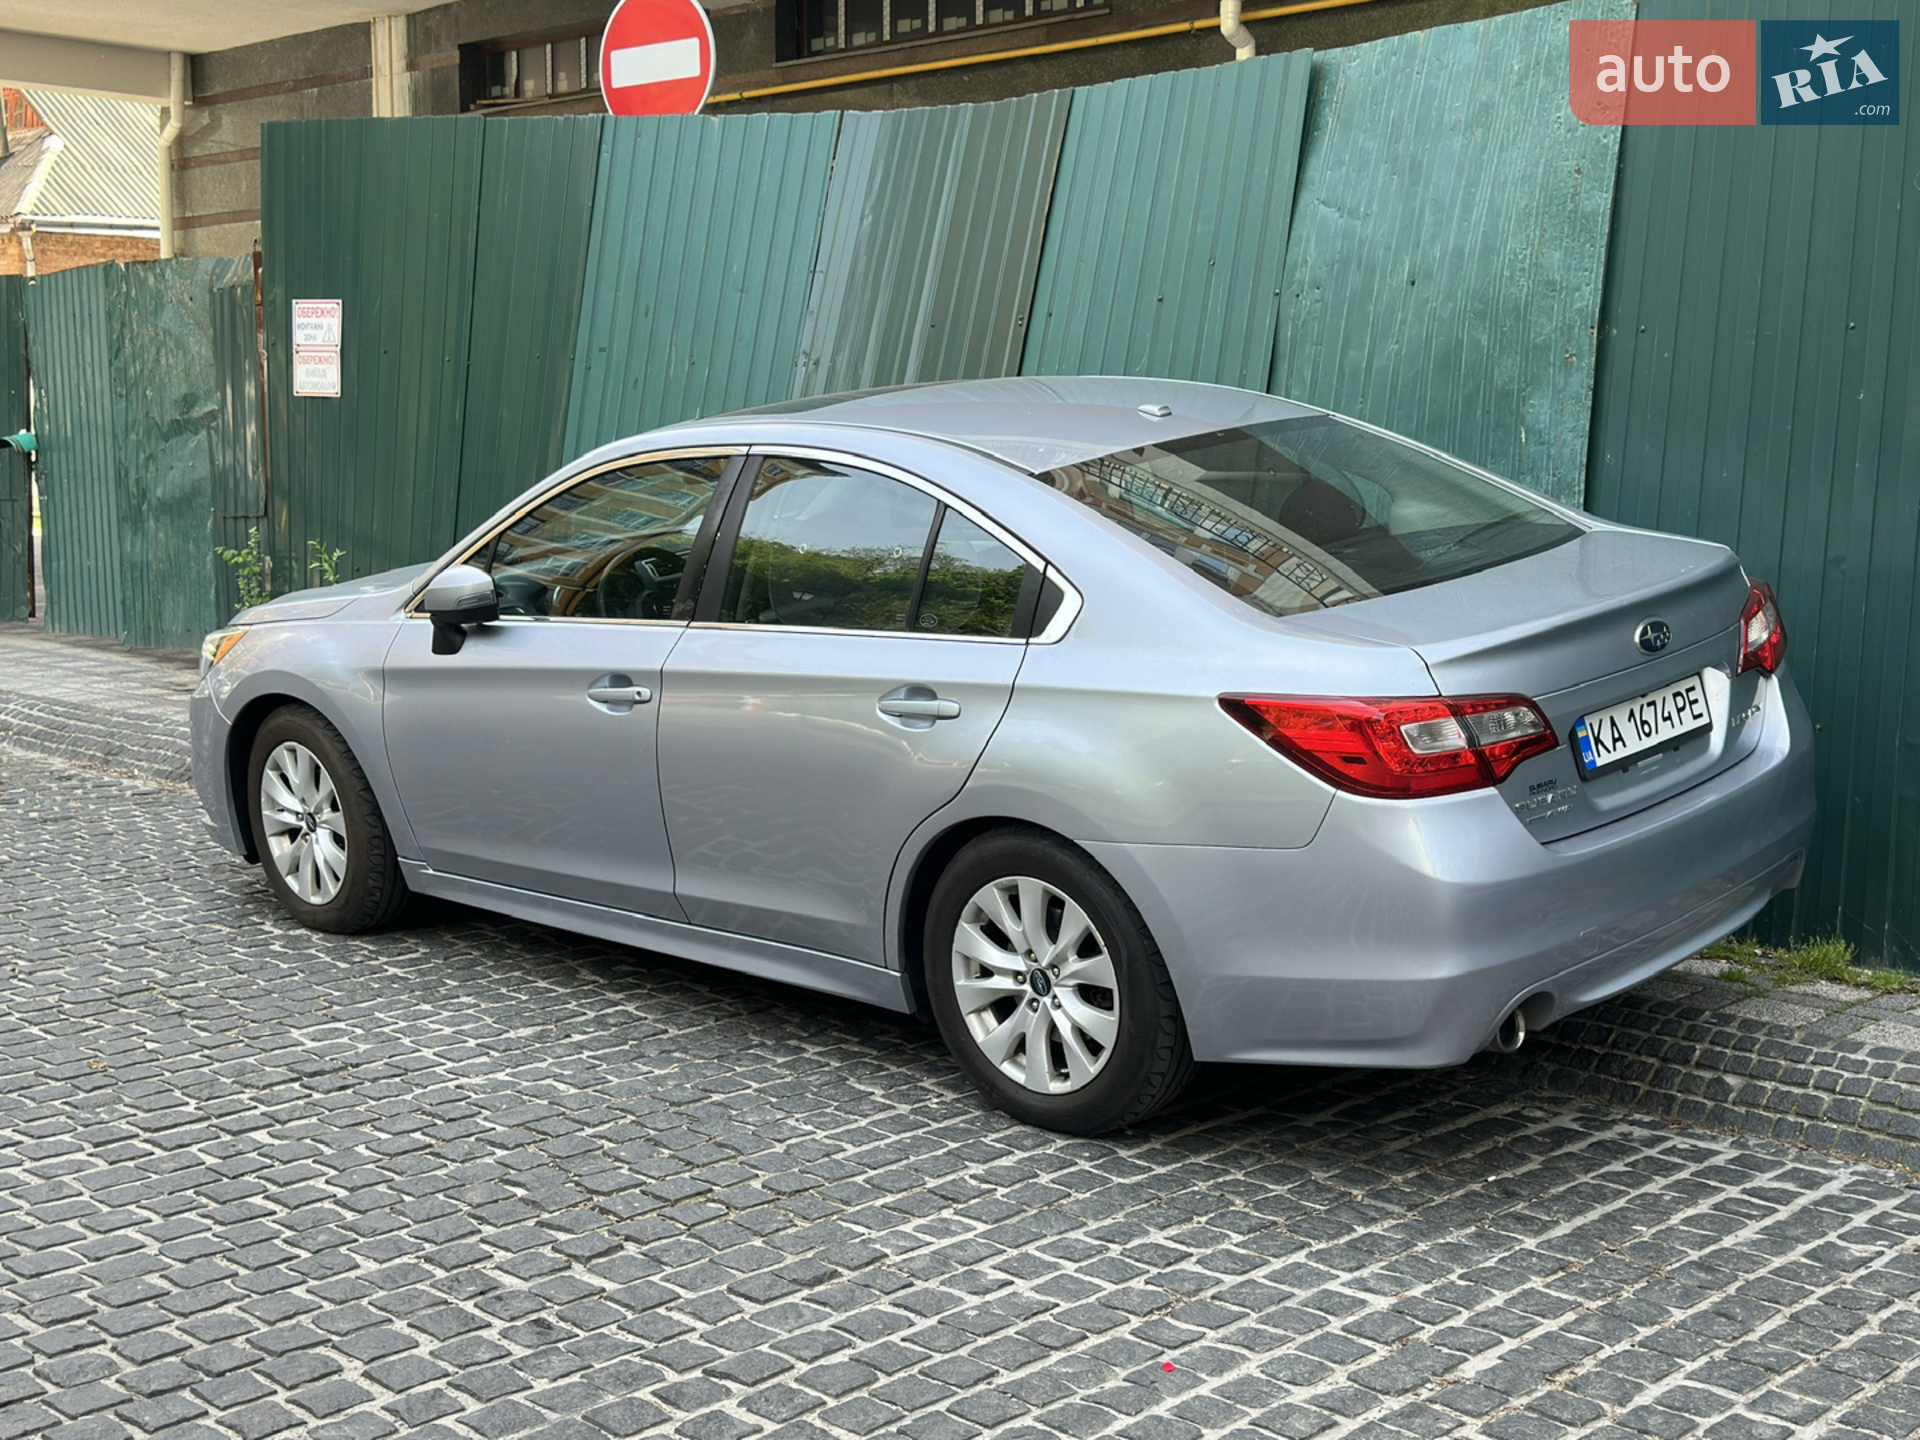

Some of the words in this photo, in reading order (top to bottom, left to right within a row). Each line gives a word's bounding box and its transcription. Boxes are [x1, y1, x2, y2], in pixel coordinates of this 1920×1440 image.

[297, 306, 338, 318] ОБЕРЕЖНО!
[298, 355, 336, 365] ОБЕРЕЖНО!
[1589, 715, 1627, 758] KA
[1627, 696, 1675, 742] 1674
[1671, 685, 1704, 727] PE
[1583, 751, 1595, 763] UA
[1528, 778, 1557, 792] SUBARU
